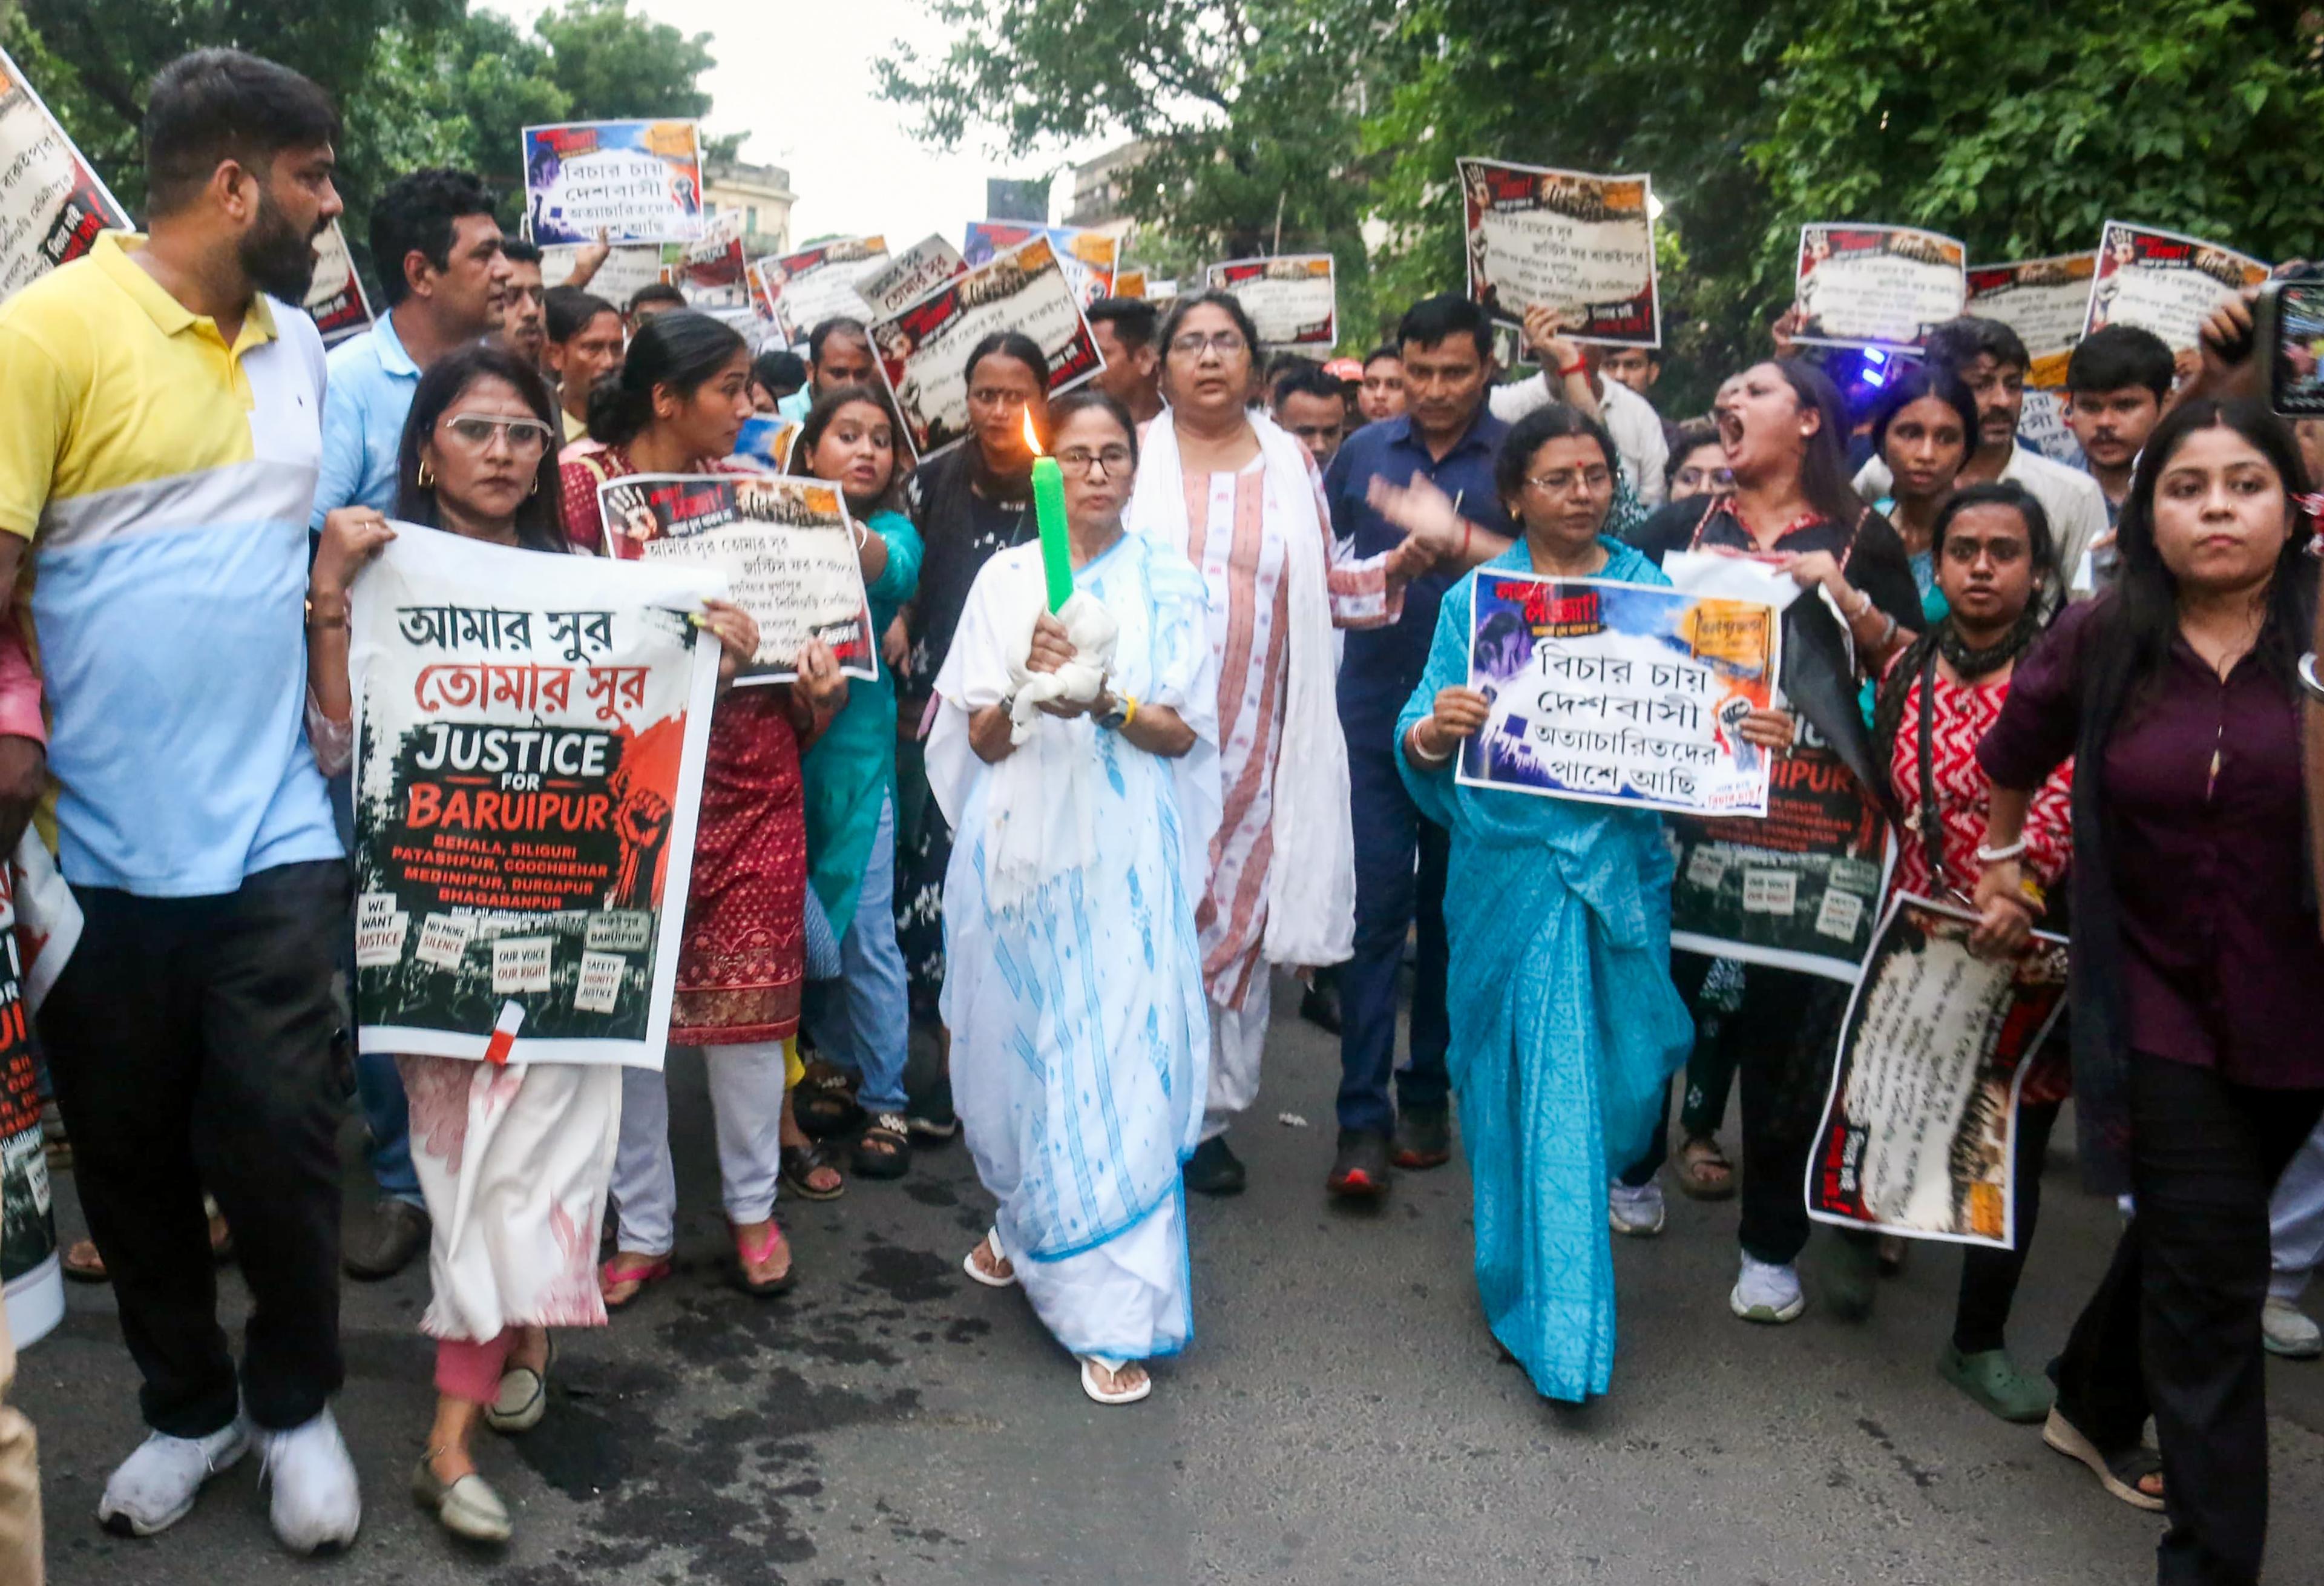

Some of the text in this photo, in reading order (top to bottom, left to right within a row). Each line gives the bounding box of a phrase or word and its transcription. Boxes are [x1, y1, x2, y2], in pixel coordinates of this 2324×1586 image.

[396, 602, 616, 666] আমার সুর
[1540, 643, 1708, 694] বিচার চায়
[414, 660, 652, 727] তোমার সুর
[1537, 691, 1703, 730] দেশবাসী
[415, 723, 609, 777] JUSTICE
[1534, 724, 1717, 766] অত্যাচারিতদের
[501, 771, 541, 792] FOR
[1551, 759, 1618, 787] পাশে
[1629, 766, 1695, 795] আছি
[405, 781, 609, 832] BARUIPUR
[433, 834, 577, 860] BEHALA, SILIGURI
[392, 845, 608, 878] PATASHPUR, COOCHBEHAR
[404, 866, 594, 895] MEDINIPUR, DURGAPUR
[369, 898, 387, 913] WE
[362, 916, 393, 929] WANT
[427, 921, 465, 938] NO MORE
[358, 930, 401, 950] JUSTICE
[424, 936, 462, 953] SILENCE
[591, 930, 643, 943] BARUIPUR
[499, 949, 545, 963] OUR VOICE
[497, 964, 546, 980] OUR RIGHT
[582, 987, 612, 998] JUSTICE
